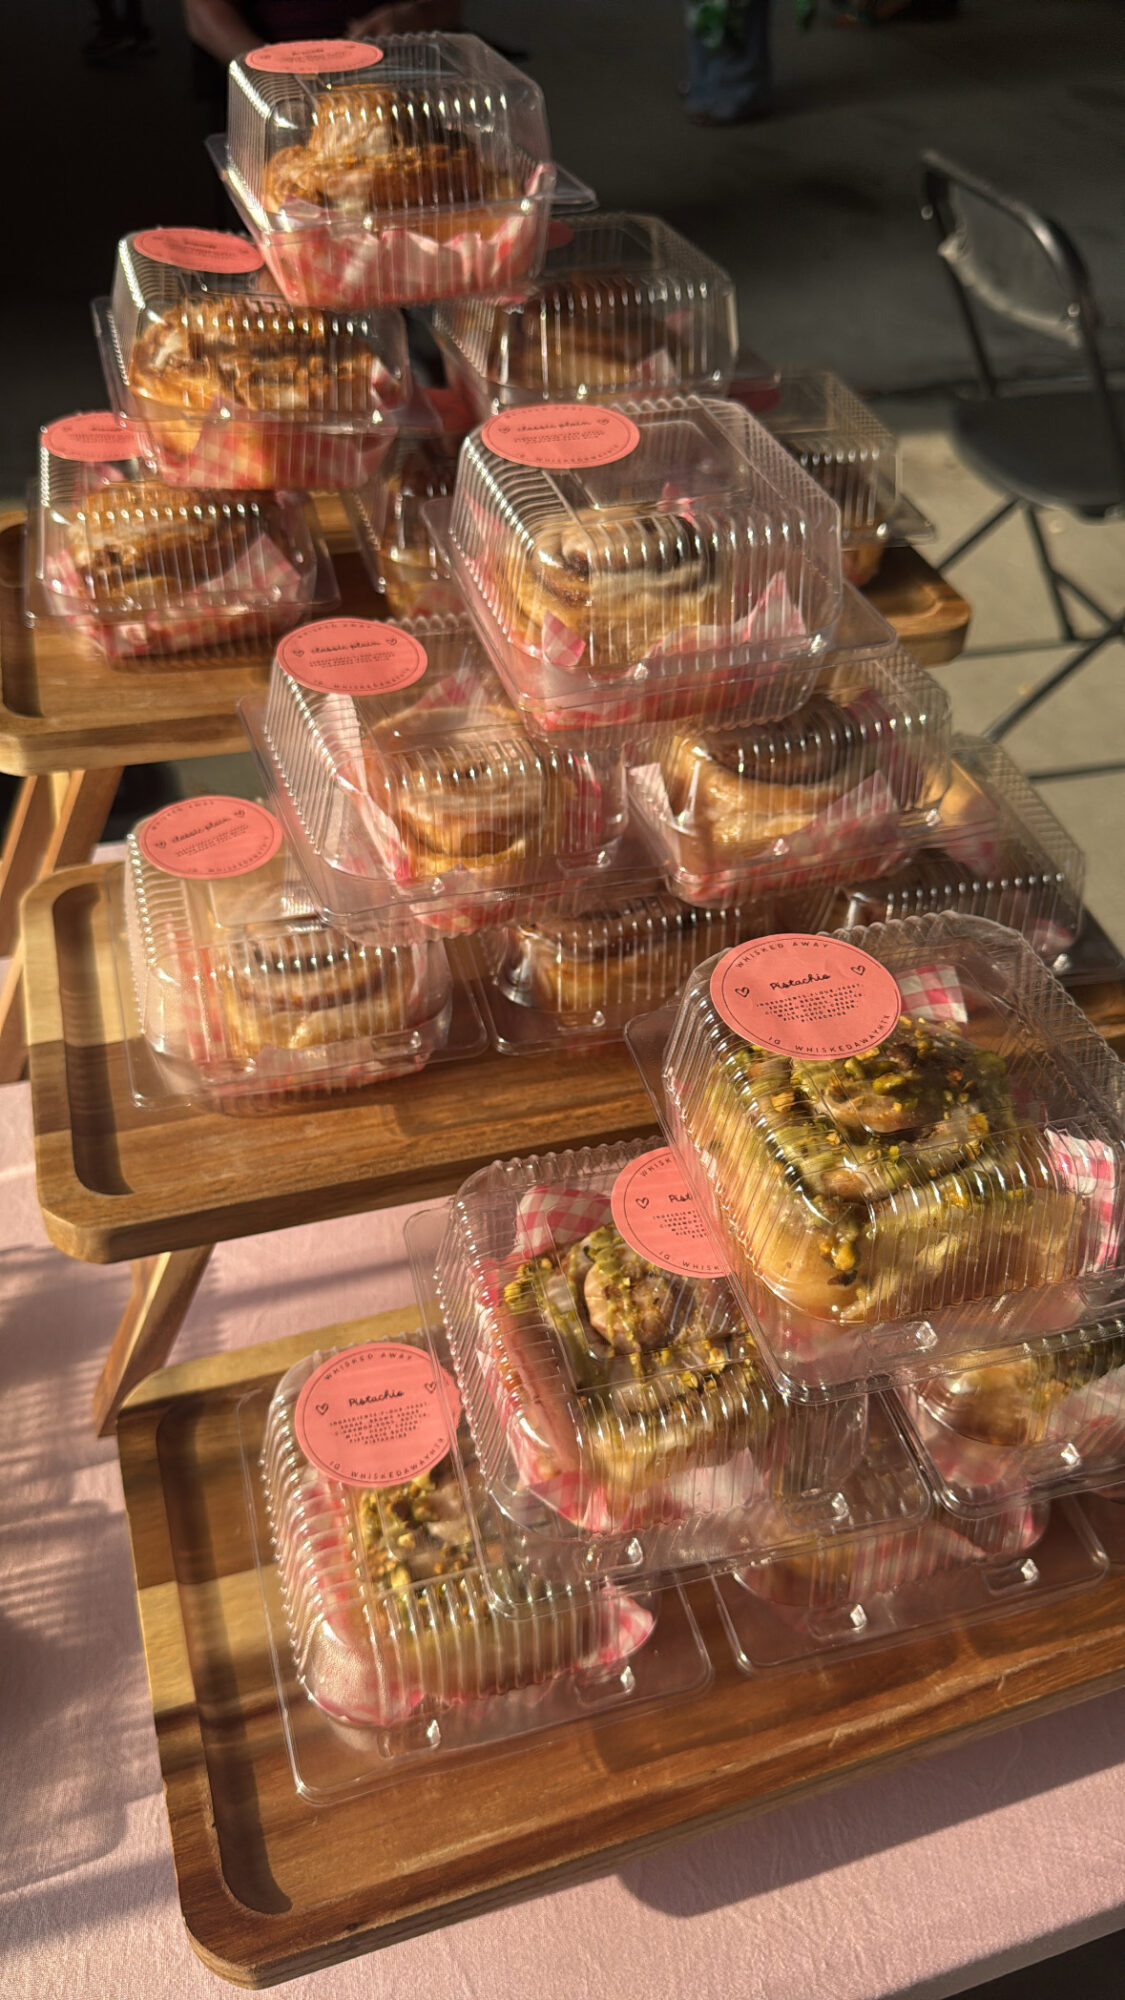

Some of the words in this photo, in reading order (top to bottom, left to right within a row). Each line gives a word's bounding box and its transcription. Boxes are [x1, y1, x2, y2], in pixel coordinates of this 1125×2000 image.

[311, 645, 348, 654] classic
[349, 641, 380, 650] plain
[735, 942, 785, 968] WHISKED
[792, 941, 829, 949] AWAY
[769, 973, 831, 990] Pistachio
[768, 1036, 781, 1045] IG
[795, 1014, 891, 1053] WHISKEDAWAYHTX
[640, 1157, 671, 1177] WHISK
[659, 1251, 671, 1260] IG
[325, 1353, 374, 1380] WHISKED
[381, 1352, 413, 1361] AWAY
[348, 1389, 404, 1407] Pistachio
[329, 1460, 341, 1470] IG
